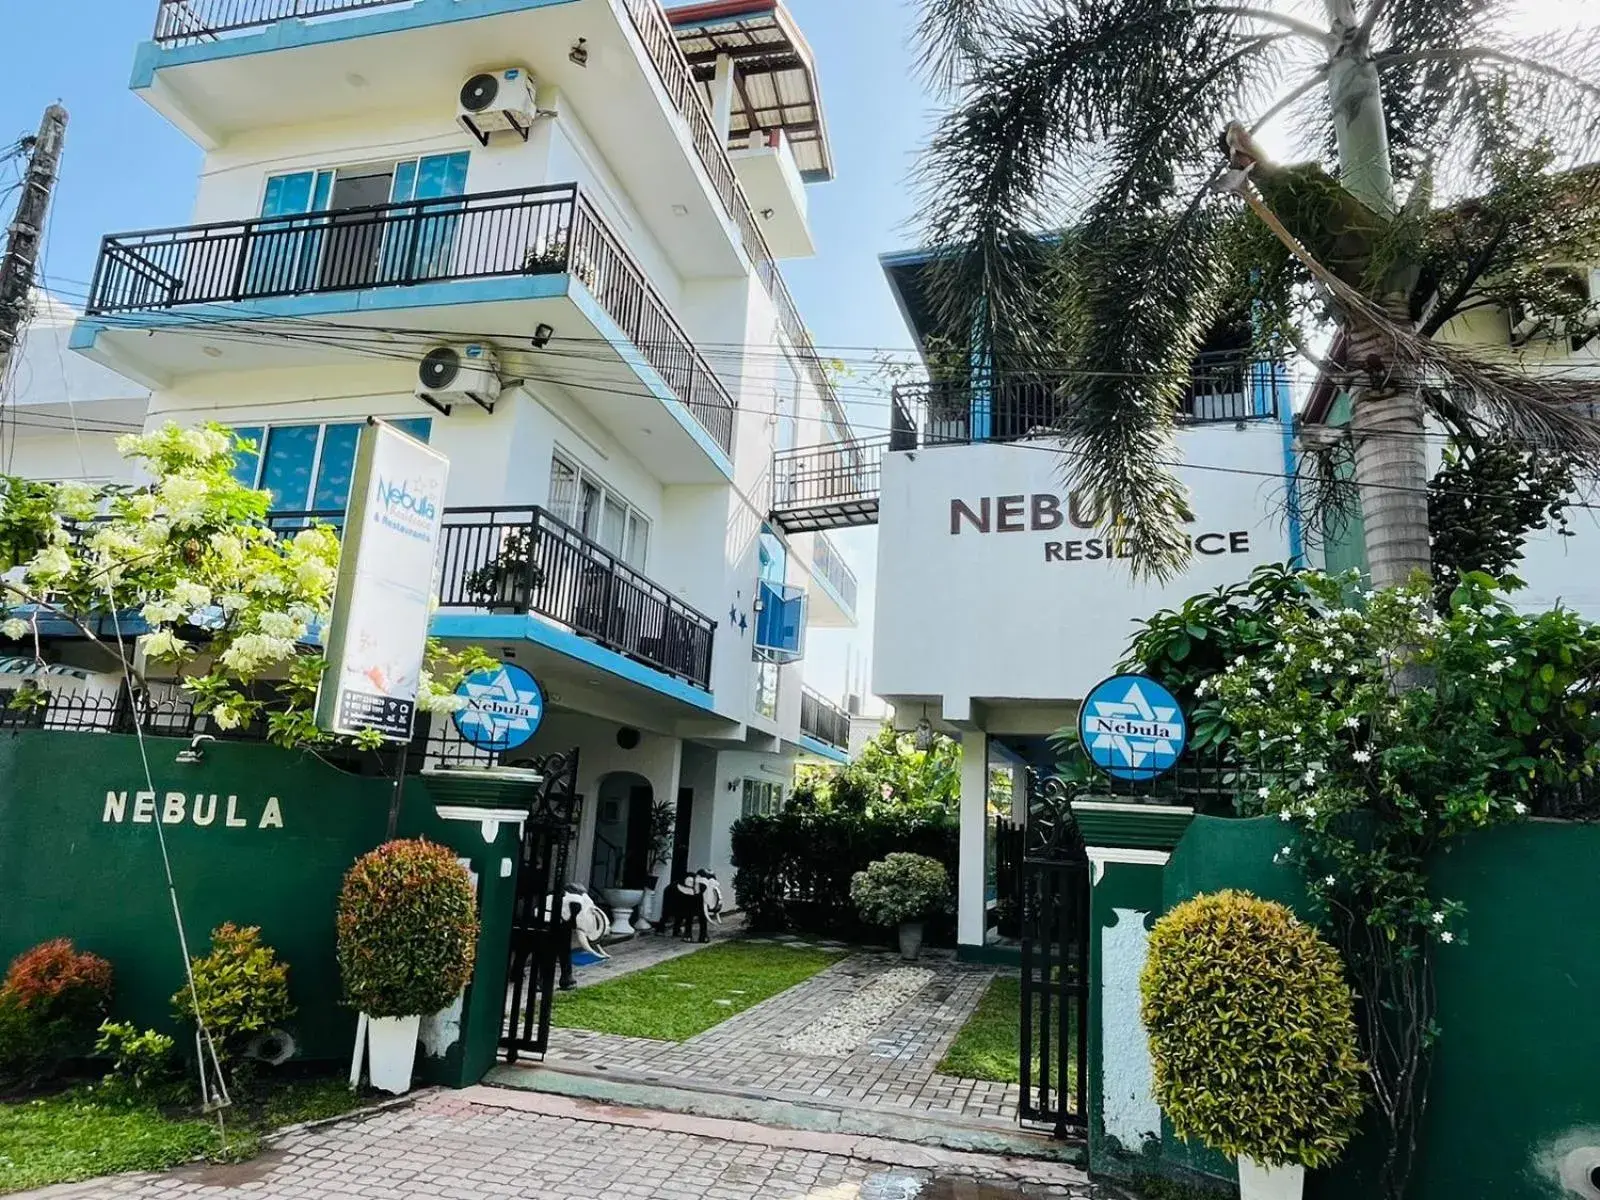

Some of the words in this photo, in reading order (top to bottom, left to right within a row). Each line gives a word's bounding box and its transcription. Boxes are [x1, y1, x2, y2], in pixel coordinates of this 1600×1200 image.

[376, 473, 434, 520] Nebula
[949, 493, 1195, 534] NEBU
[468, 698, 529, 716] Nebula
[1097, 719, 1170, 738] Nebula
[102, 791, 284, 829] NEBULA
